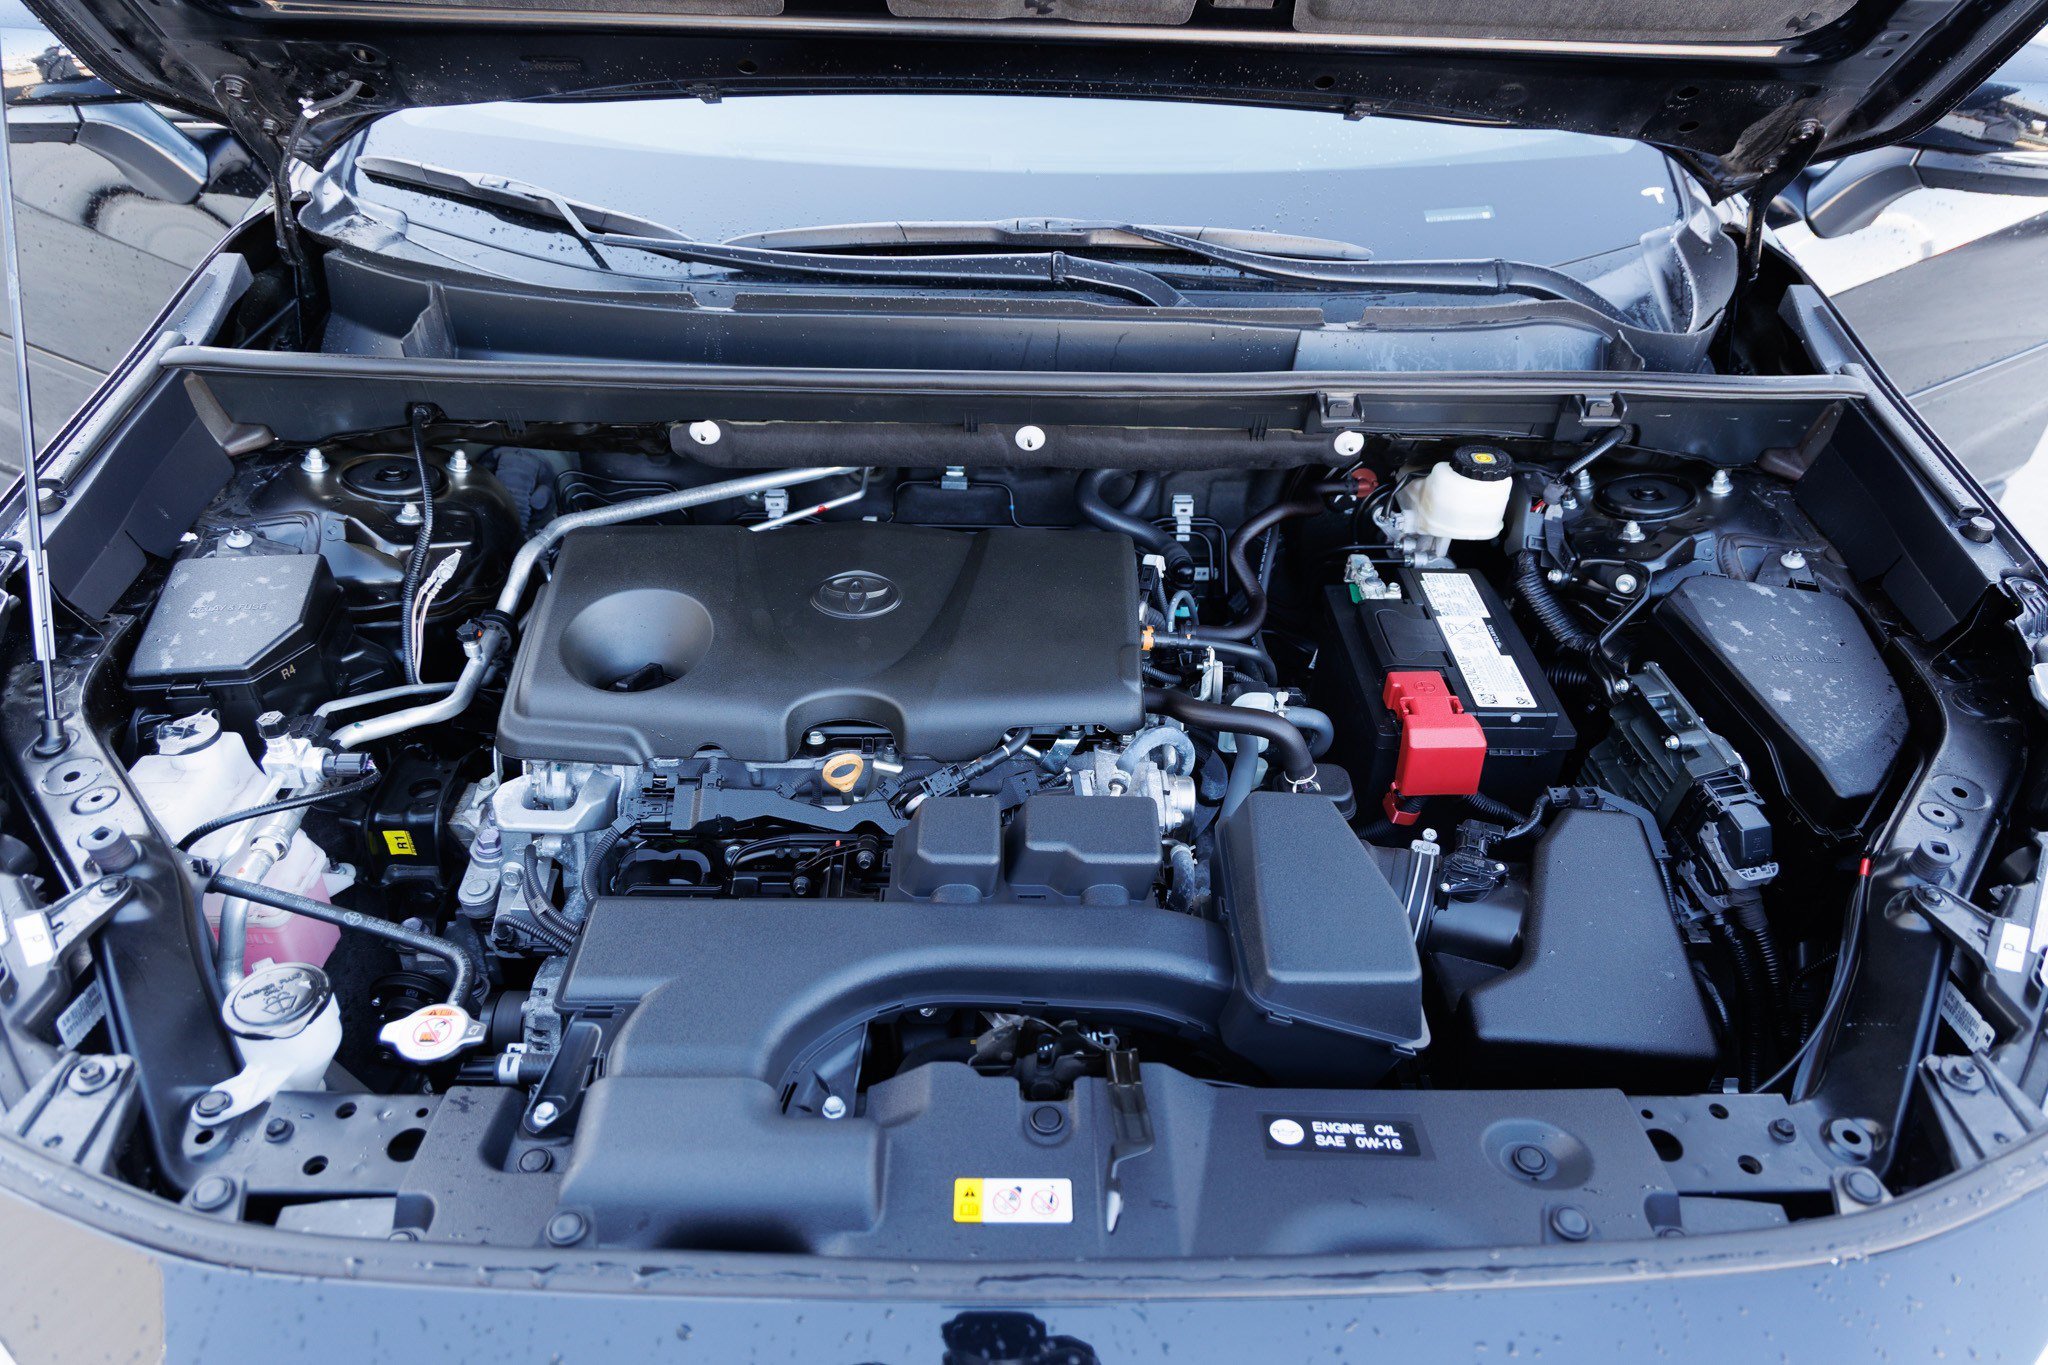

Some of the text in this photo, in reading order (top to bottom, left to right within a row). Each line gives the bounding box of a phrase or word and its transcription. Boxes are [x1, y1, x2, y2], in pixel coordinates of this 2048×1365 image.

[190, 604, 227, 614] RELAY
[238, 602, 267, 611] FUSE
[281, 664, 296, 680] R4
[394, 836, 409, 850] R1
[1311, 1121, 1399, 1137] ENGINE OIL
[1314, 1134, 1403, 1150] SAE 0W-16
